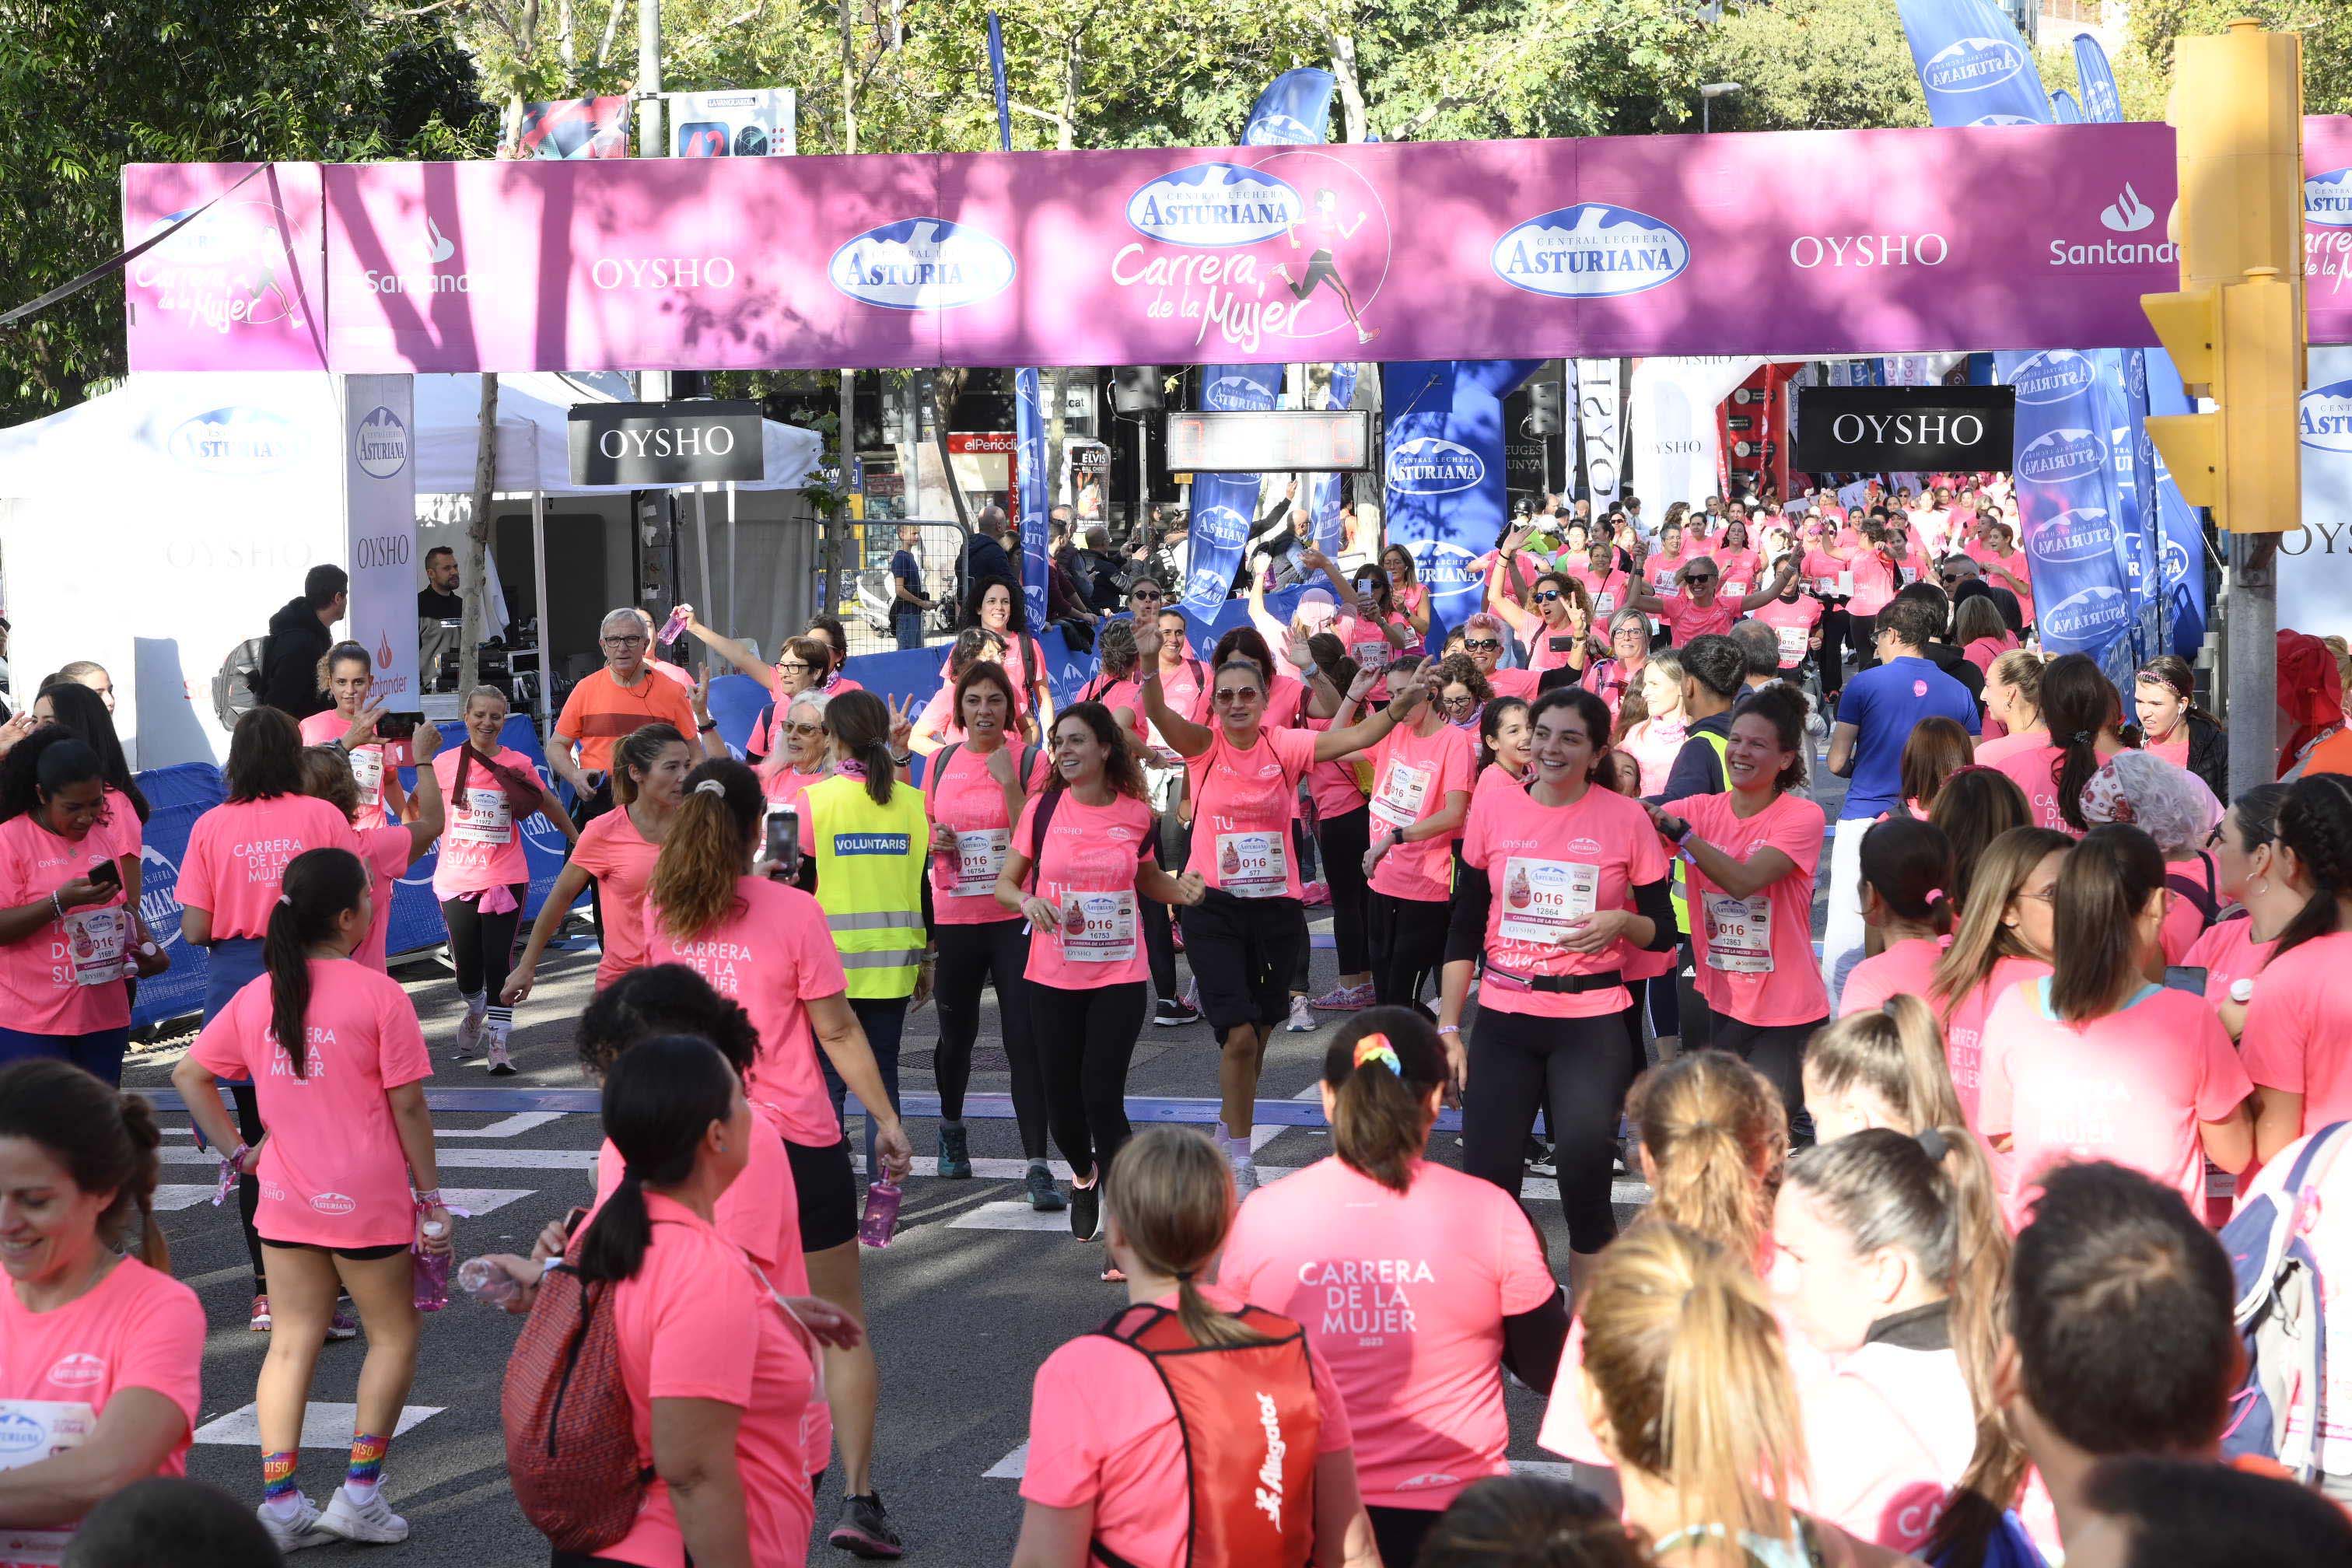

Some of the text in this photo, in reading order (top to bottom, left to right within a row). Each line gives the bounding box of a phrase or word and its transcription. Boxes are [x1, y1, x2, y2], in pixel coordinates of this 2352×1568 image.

[716, 98, 754, 107] VANGUARDIA
[1228, 191, 1283, 199] LECHERA
[1139, 194, 1289, 226] ASTURIANA
[1537, 234, 1668, 246] CENTRAL LECHERA
[1507, 240, 1675, 275] ASTURIANA
[1790, 233, 1948, 268] OYSHO
[1112, 243, 1258, 286] Carrera
[2322, 254, 2336, 275] la
[593, 257, 735, 289] OYSHO
[1147, 282, 1312, 354] de la Mujer
[1832, 414, 1983, 446] OYSHO
[359, 433, 405, 461] ASTURIANA
[600, 425, 734, 459] OYSHO
[1082, 453, 1107, 464] ELVIS
[1389, 460, 1478, 481] ASTURIANA
[2277, 522, 2352, 556] OY
[357, 534, 409, 569] OYSHO
[1391, 787, 1405, 798] 016
[474, 809, 495, 819] 016
[1053, 827, 1083, 835] OYSHO
[1212, 815, 1234, 831] TU
[233, 838, 304, 857] CARRERA
[836, 839, 907, 851] VOLUNTARIS
[1501, 839, 1538, 849] OYSHO
[1570, 842, 1599, 852] ASTURIANA
[248, 852, 290, 869] DE LA
[447, 851, 488, 865] SUMA
[964, 856, 988, 866] 016
[1242, 857, 1267, 868] 016
[1533, 891, 1563, 905] 016
[1536, 907, 1559, 916] 12864
[1715, 906, 1746, 915] ASTURIANA
[1087, 919, 1113, 930] 016
[1512, 915, 1538, 924] CARRERA
[1719, 922, 1745, 936] 016
[93, 936, 114, 950] 016
[1722, 938, 1742, 947] 12863
[671, 939, 753, 963] CARRERA
[715, 959, 735, 977] LA
[1951, 1048, 1976, 1069] DE LA
[271, 1060, 325, 1077] MUER
[312, 1199, 352, 1210] ASTURIANA
[1298, 1258, 1435, 1287] CARRERA
[1326, 1285, 1411, 1310] DE LA
[1321, 1309, 1417, 1335] MUJER
[352, 1441, 374, 1458] OTSO
[264, 1461, 289, 1472] OTSO
